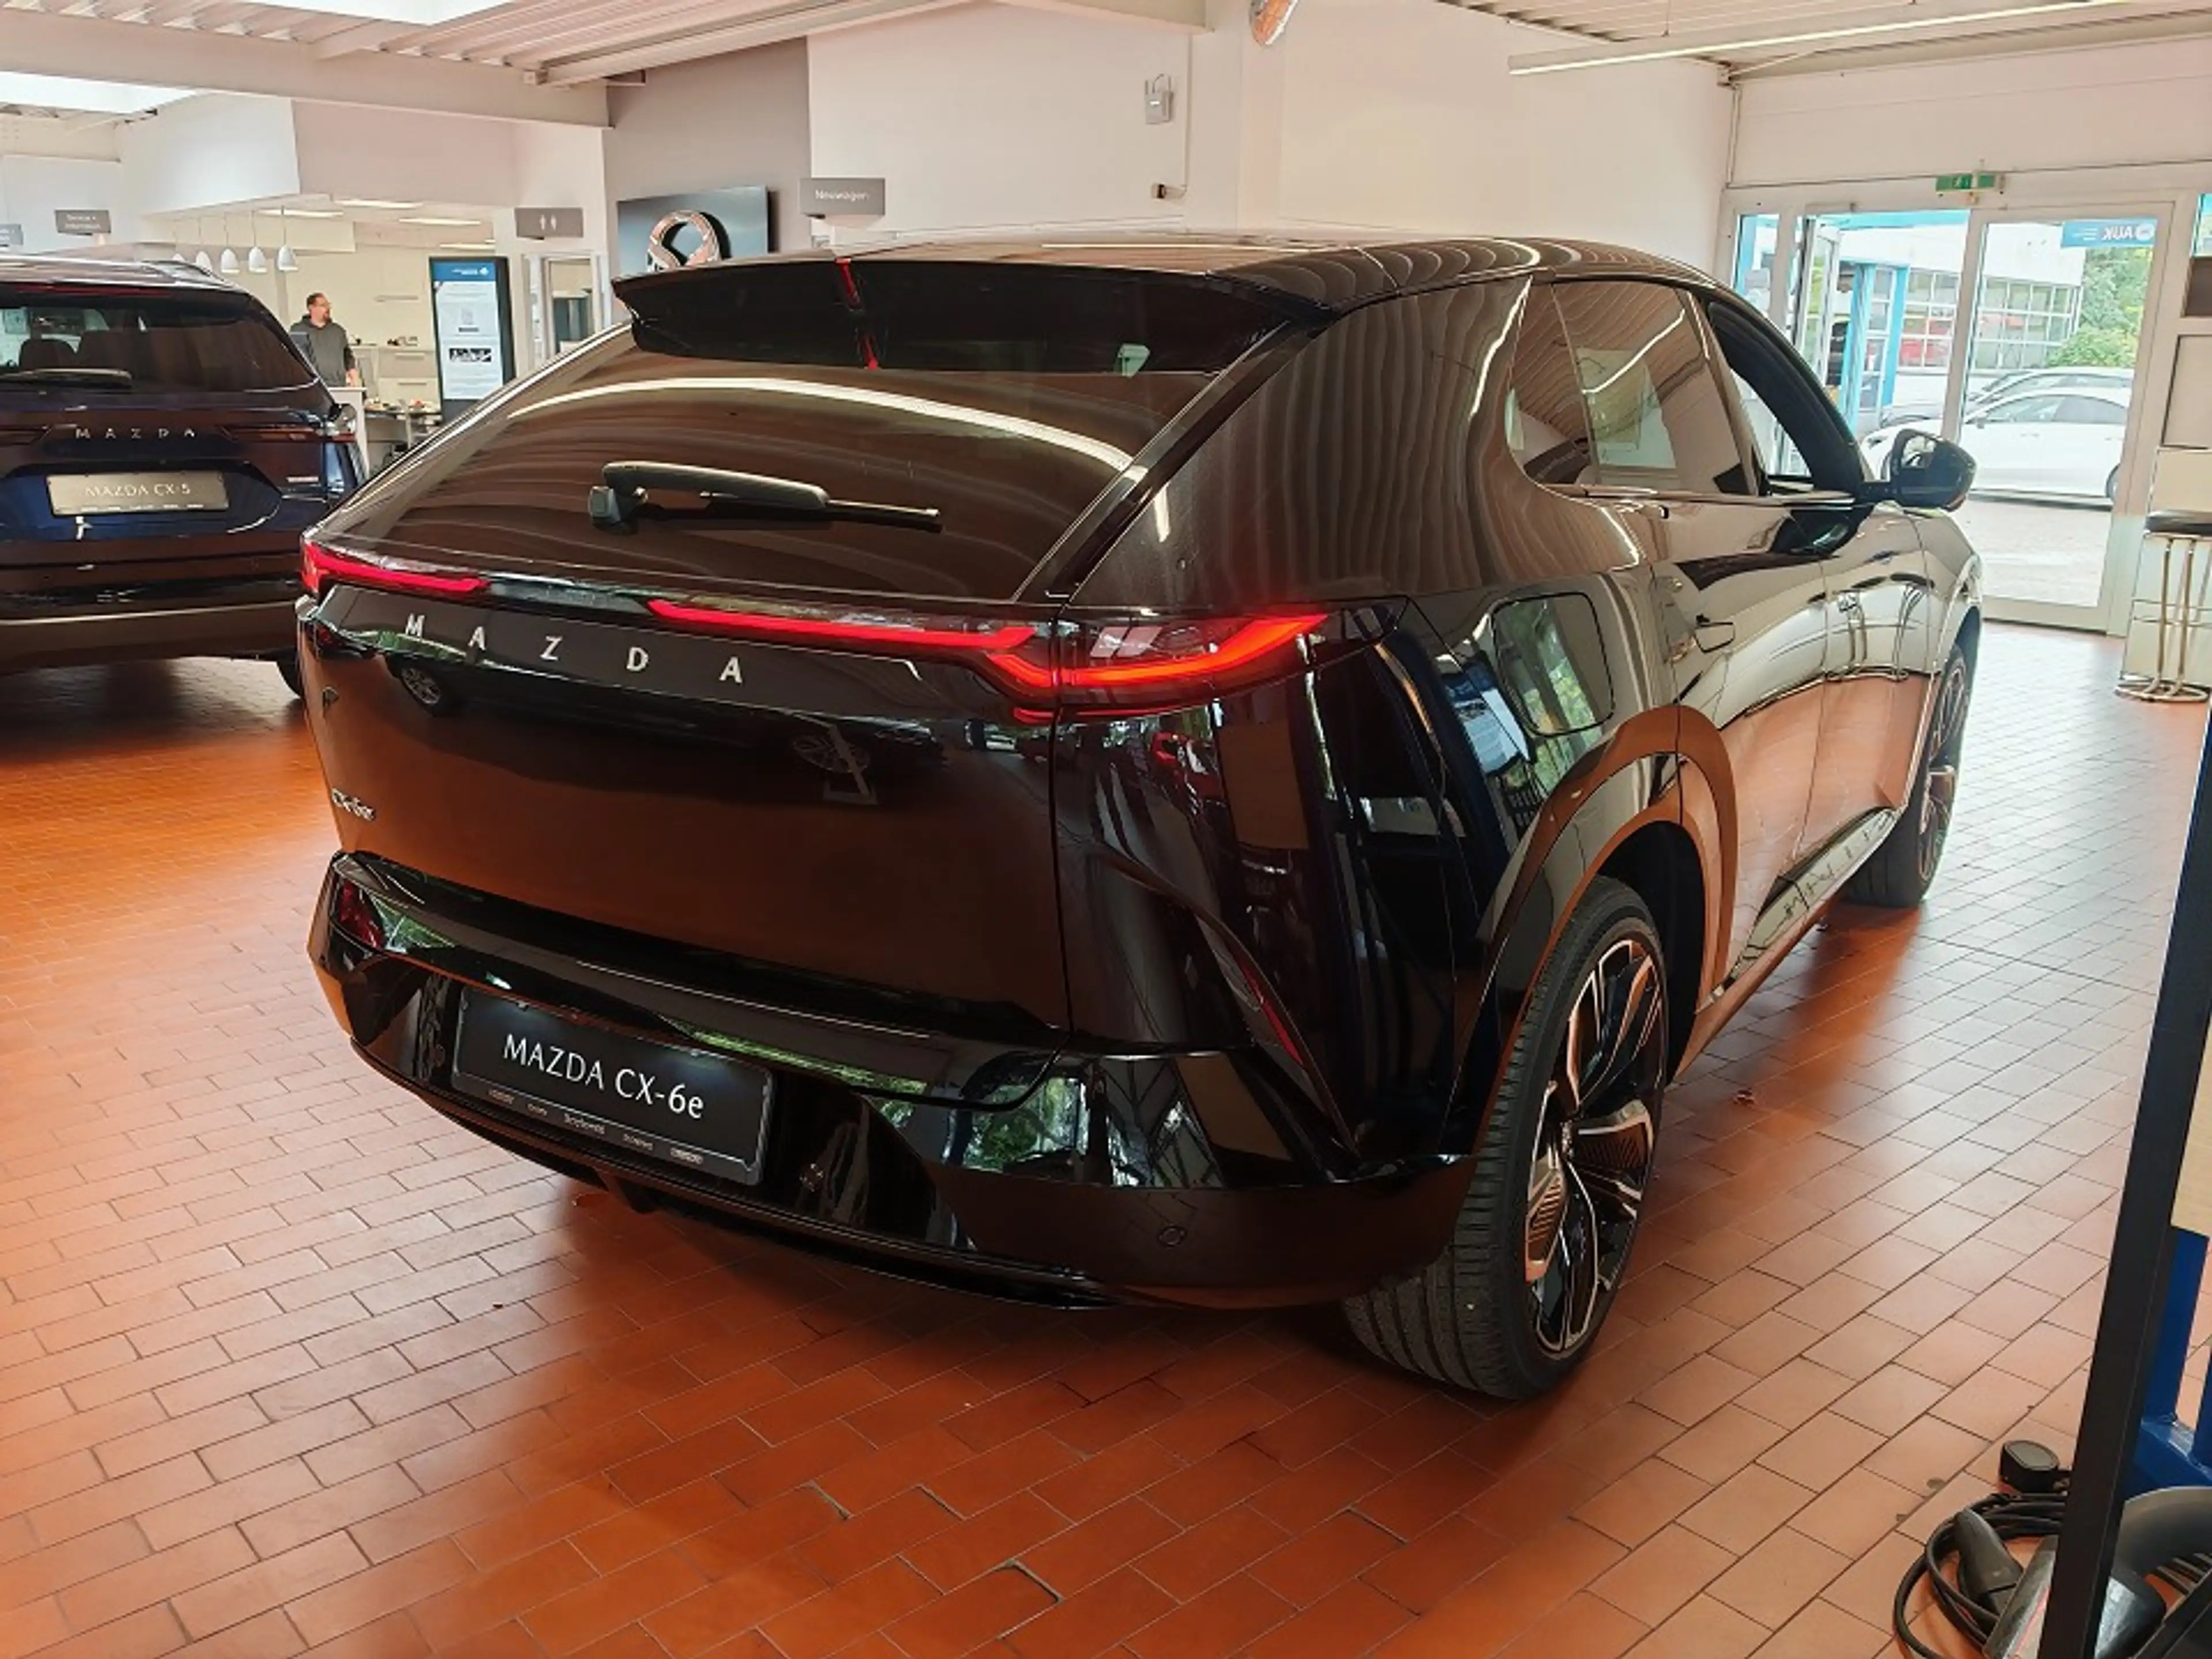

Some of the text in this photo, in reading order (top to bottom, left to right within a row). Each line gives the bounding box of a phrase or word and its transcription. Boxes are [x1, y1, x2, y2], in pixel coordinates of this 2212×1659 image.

[75, 428, 195, 438] MAZDA
[86, 483, 191, 497] MAZDA CX-5
[404, 613, 743, 684] MAZDA
[503, 1033, 704, 1119] MAZDA CX-6e
